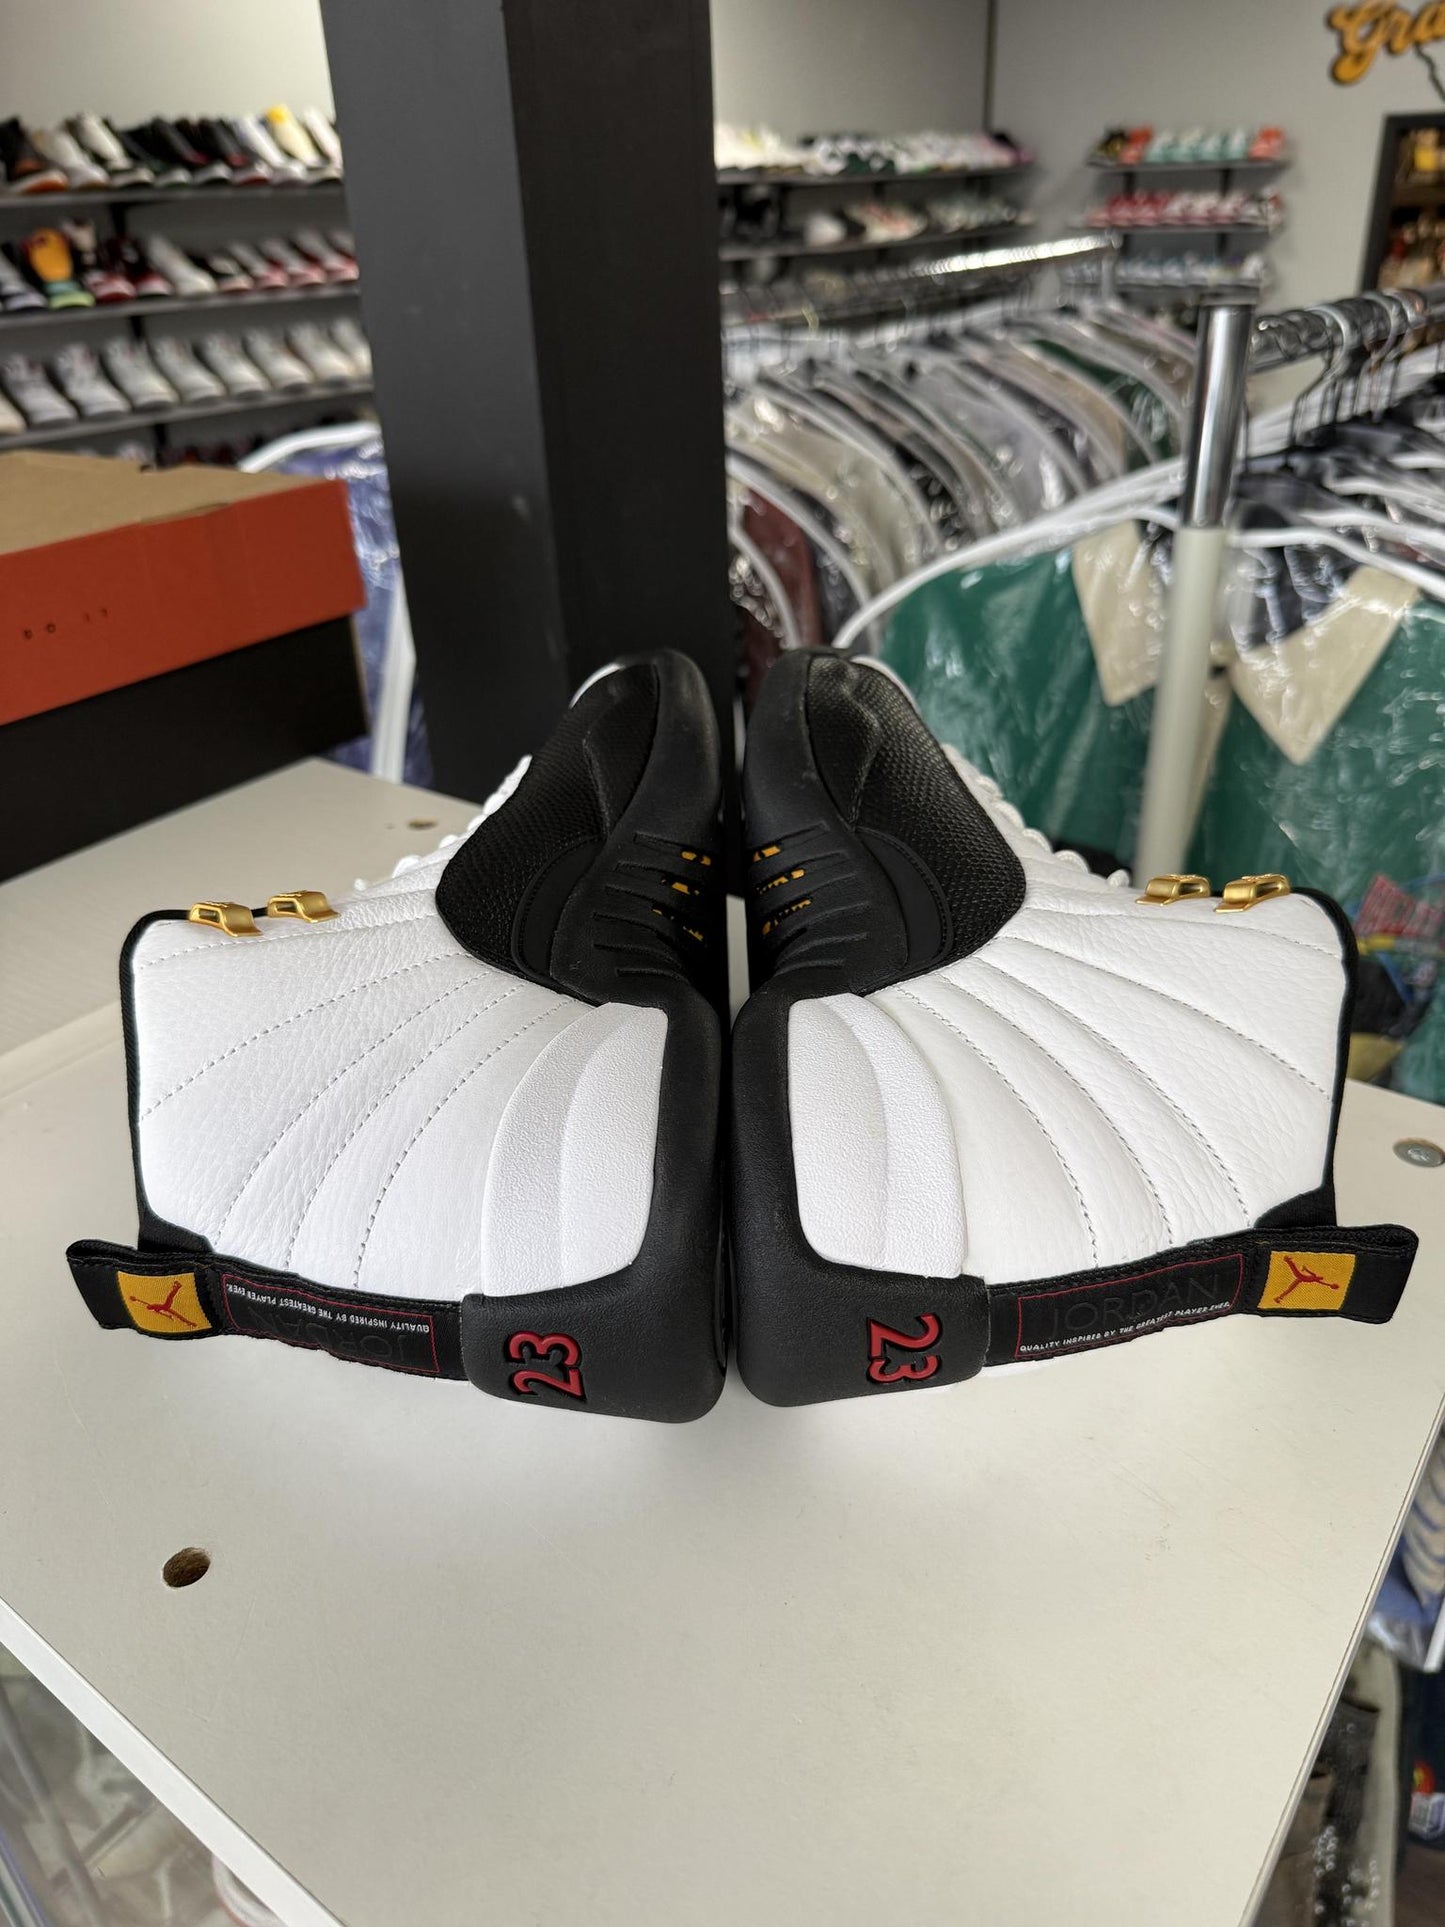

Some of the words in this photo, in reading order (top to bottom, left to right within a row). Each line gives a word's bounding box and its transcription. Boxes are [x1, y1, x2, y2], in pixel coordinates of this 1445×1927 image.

[247, 1291, 277, 1305] PLAYER
[279, 1298, 317, 1315] GREATEST
[1047, 1272, 1217, 1340] JORDAN
[318, 1308, 333, 1320] THE
[335, 1312, 347, 1322] BY
[349, 1315, 388, 1329] INSPIRED
[390, 1323, 430, 1334] QUALITY
[1019, 1340, 1060, 1352] QUALITY
[1062, 1332, 1102, 1345] INSPIRED
[1103, 1329, 1116, 1338] BY
[1119, 1325, 1135, 1334] THE
[1135, 1310, 1173, 1330] GREATEST
[1174, 1306, 1208, 1317] PLAYER
[869, 1312, 940, 1383] 23
[508, 1331, 582, 1396] 23
